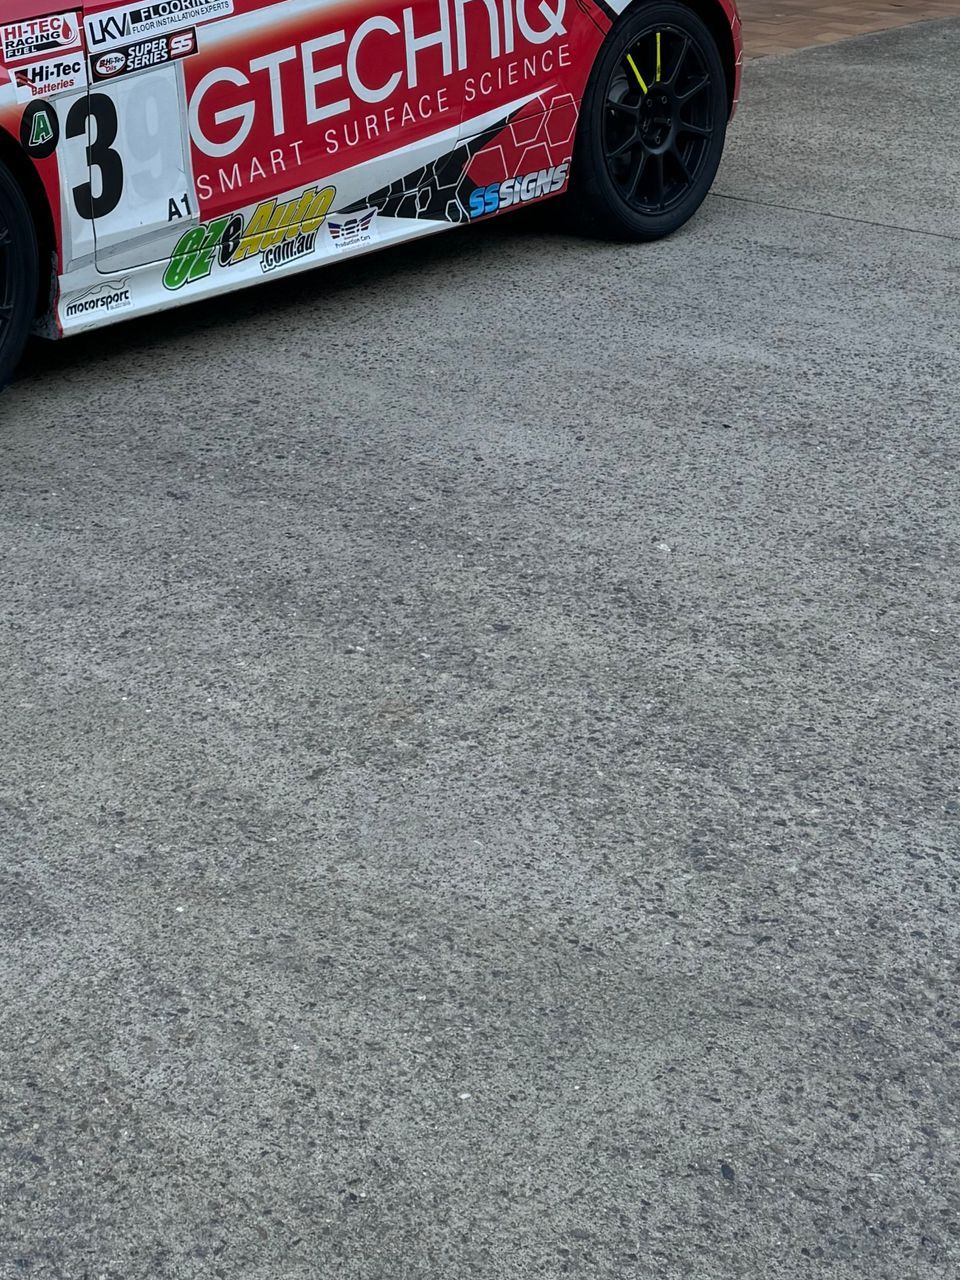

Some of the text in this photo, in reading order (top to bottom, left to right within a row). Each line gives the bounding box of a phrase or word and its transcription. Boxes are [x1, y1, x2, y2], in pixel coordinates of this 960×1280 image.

[3, 18, 61, 40] HI-TEC
[132, 0, 230, 35] FLOOR INSTALLATION EXPERTS
[5, 31, 60, 50] RACING
[7, 46, 37, 58] FUEL
[128, 38, 167, 59] SUPER
[126, 49, 169, 71] SERIES
[31, 61, 81, 84] Hi-Tec
[31, 79, 75, 96] Batteries
[28, 111, 54, 146] A
[196, 44, 572, 200] SMART SURFACE SCIENCE
[167, 193, 192, 222] A1
[262, 232, 315, 269] .com.au
[66, 290, 130, 317] motorsport
